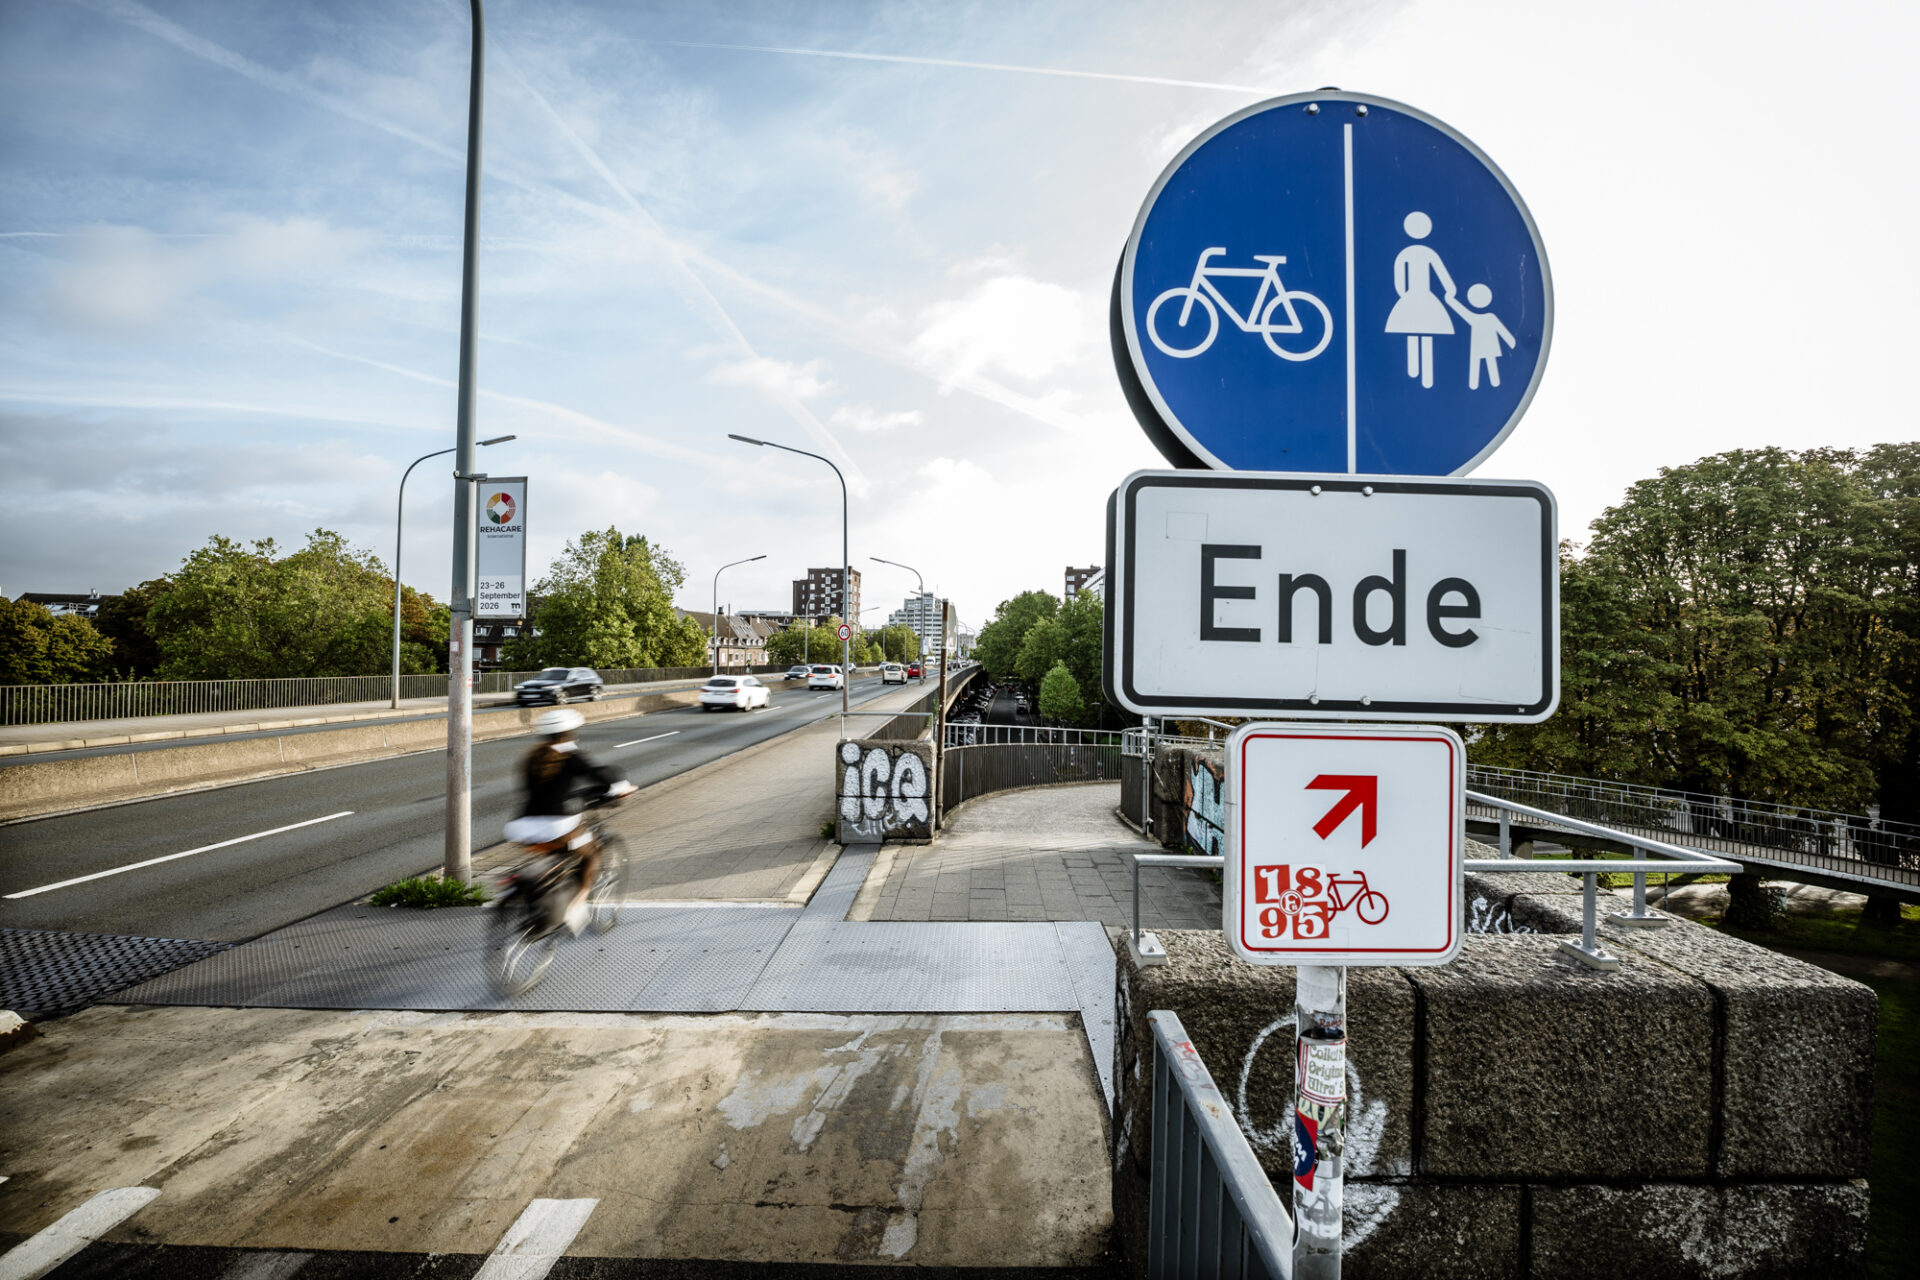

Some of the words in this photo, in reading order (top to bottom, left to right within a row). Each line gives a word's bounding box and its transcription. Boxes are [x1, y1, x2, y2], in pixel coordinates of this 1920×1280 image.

[480, 525, 522, 533] REHACARE
[480, 591, 520, 601] September
[1200, 543, 1481, 648] Ende
[480, 602, 500, 610] 2026
[840, 628, 849, 637] 60
